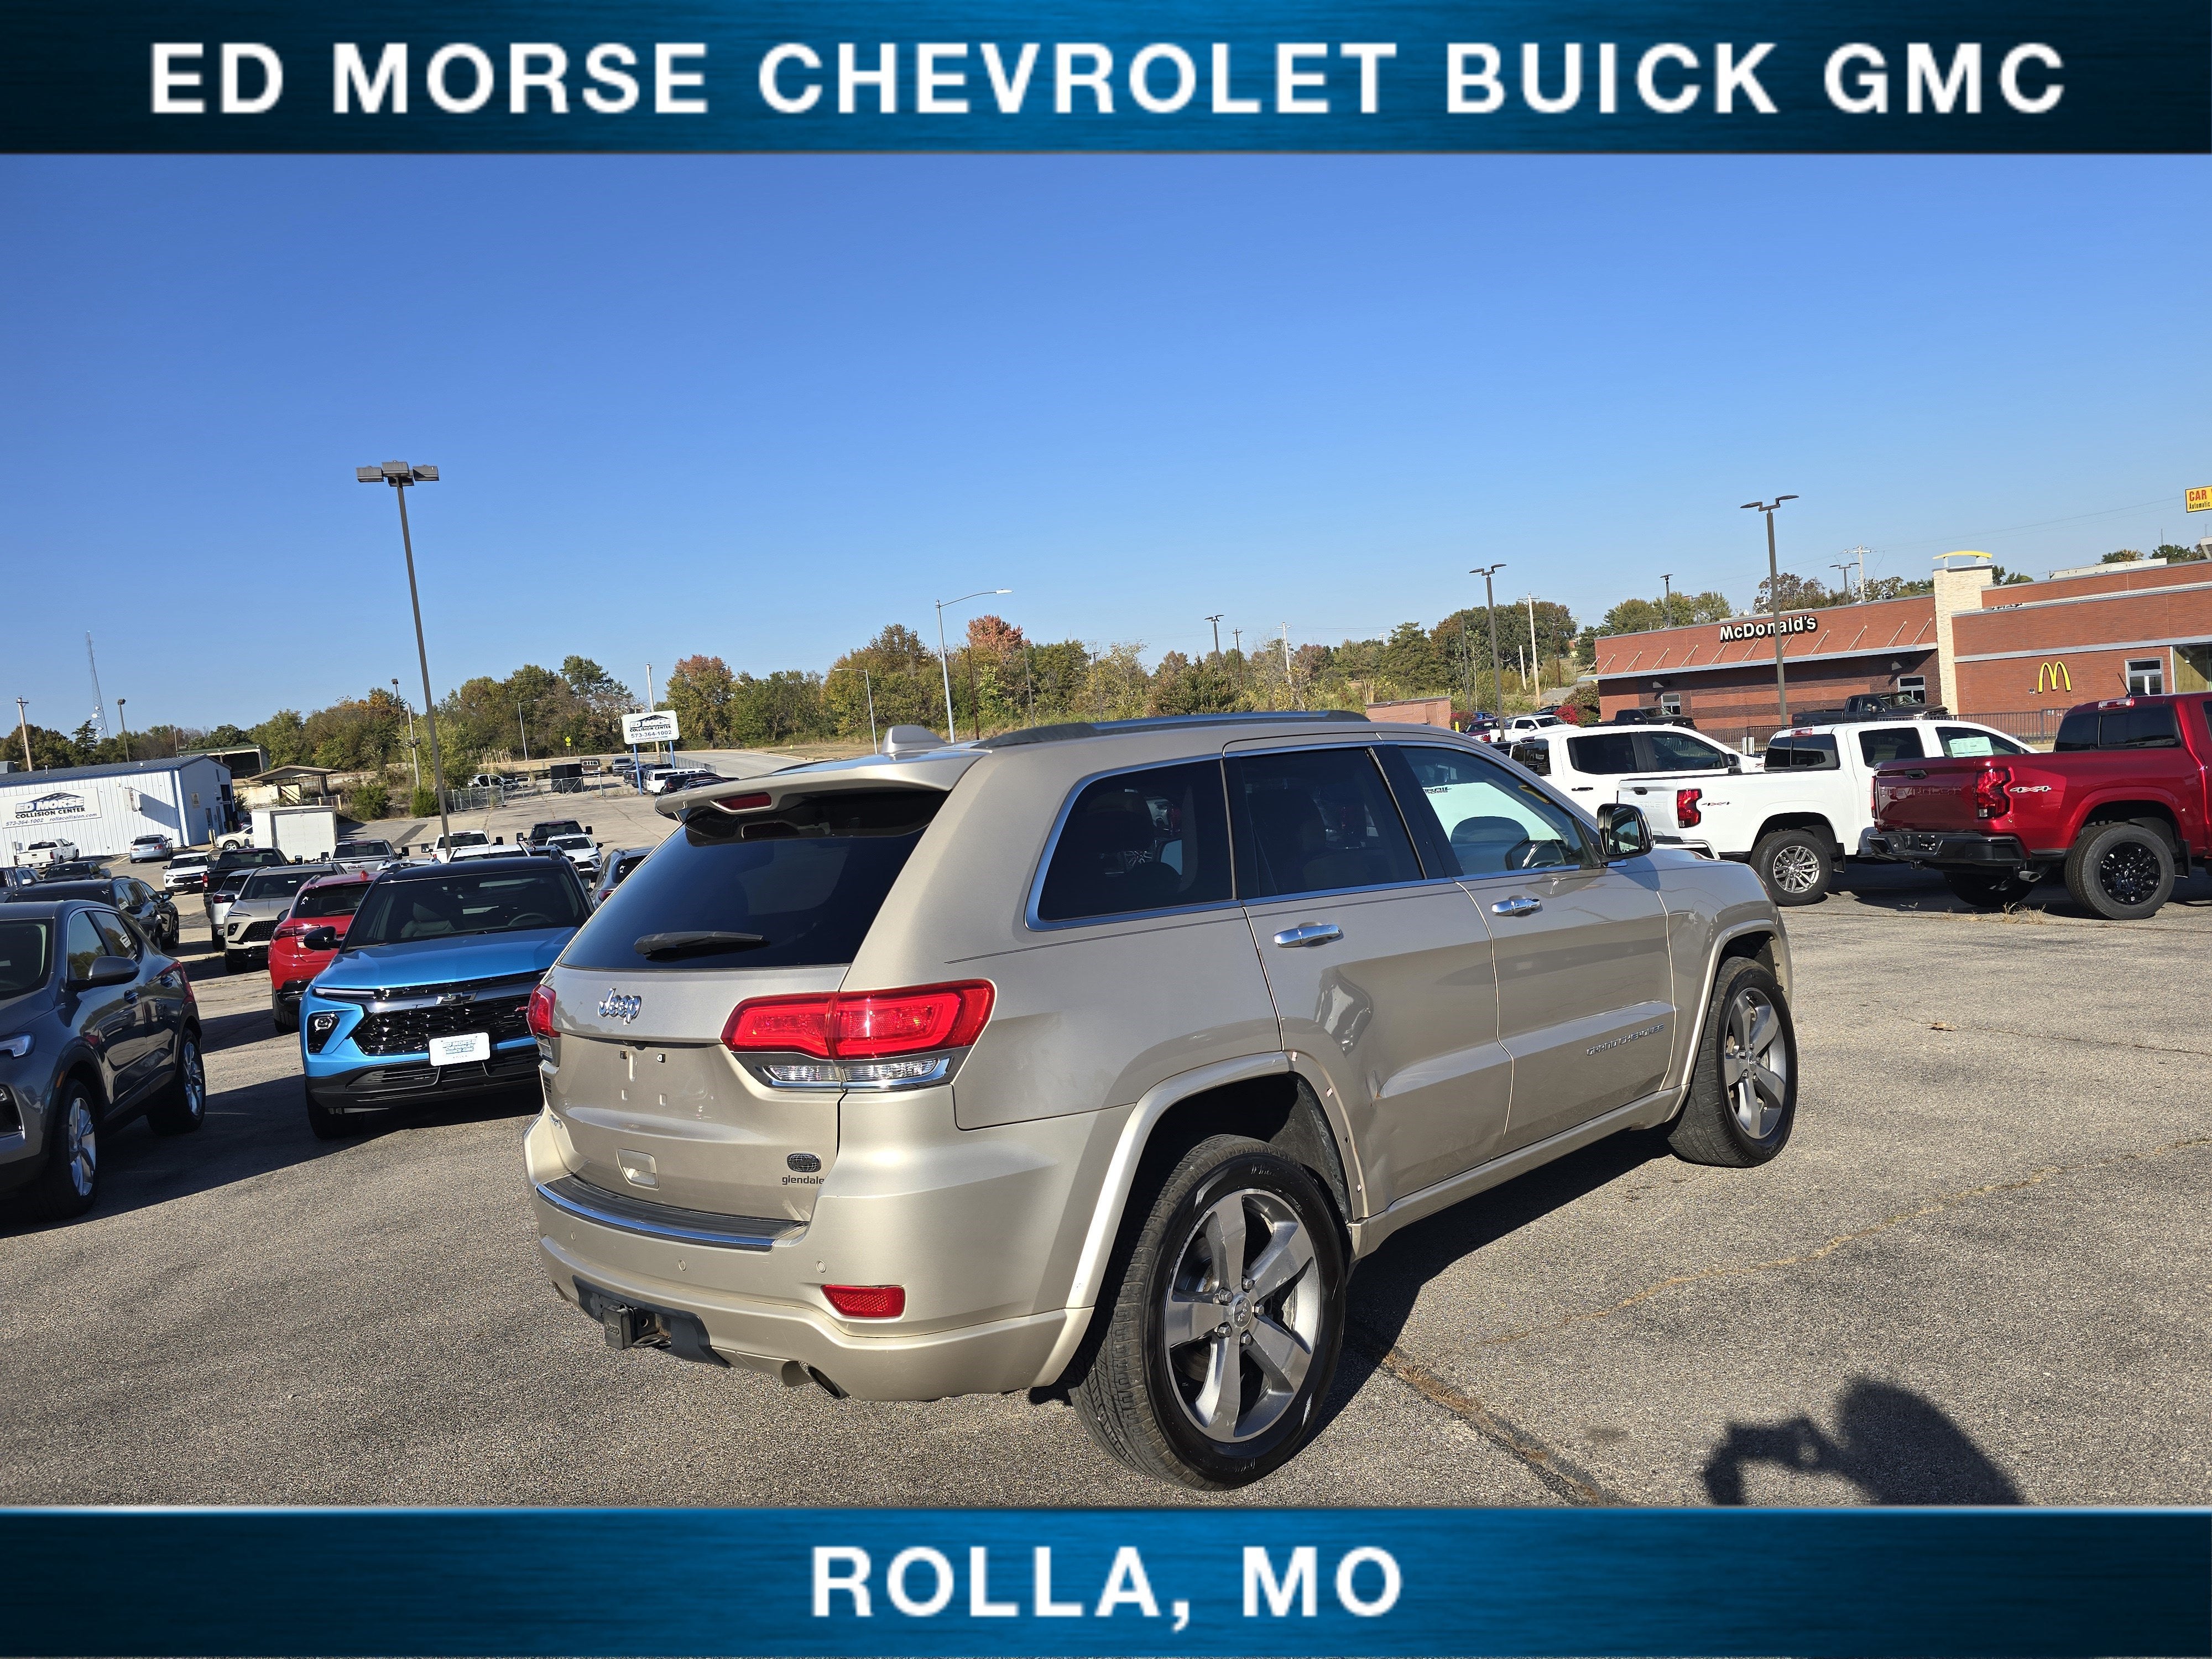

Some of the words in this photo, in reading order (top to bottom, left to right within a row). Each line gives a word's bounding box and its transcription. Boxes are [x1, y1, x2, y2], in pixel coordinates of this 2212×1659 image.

[2189, 490, 2206, 501] CAR
[2189, 501, 2210, 509] Automatic
[1720, 615, 1817, 641] McDonald's
[631, 730, 672, 738] 573-364-1002
[15, 802, 35, 814] ED
[35, 797, 85, 812] MORSE
[6, 818, 44, 826] 573-364-1002
[50, 813, 97, 822] rollacollision.com
[15, 811, 55, 819] COLLISION
[598, 987, 641, 1024] Jeep
[782, 1175, 825, 1185] glendale
